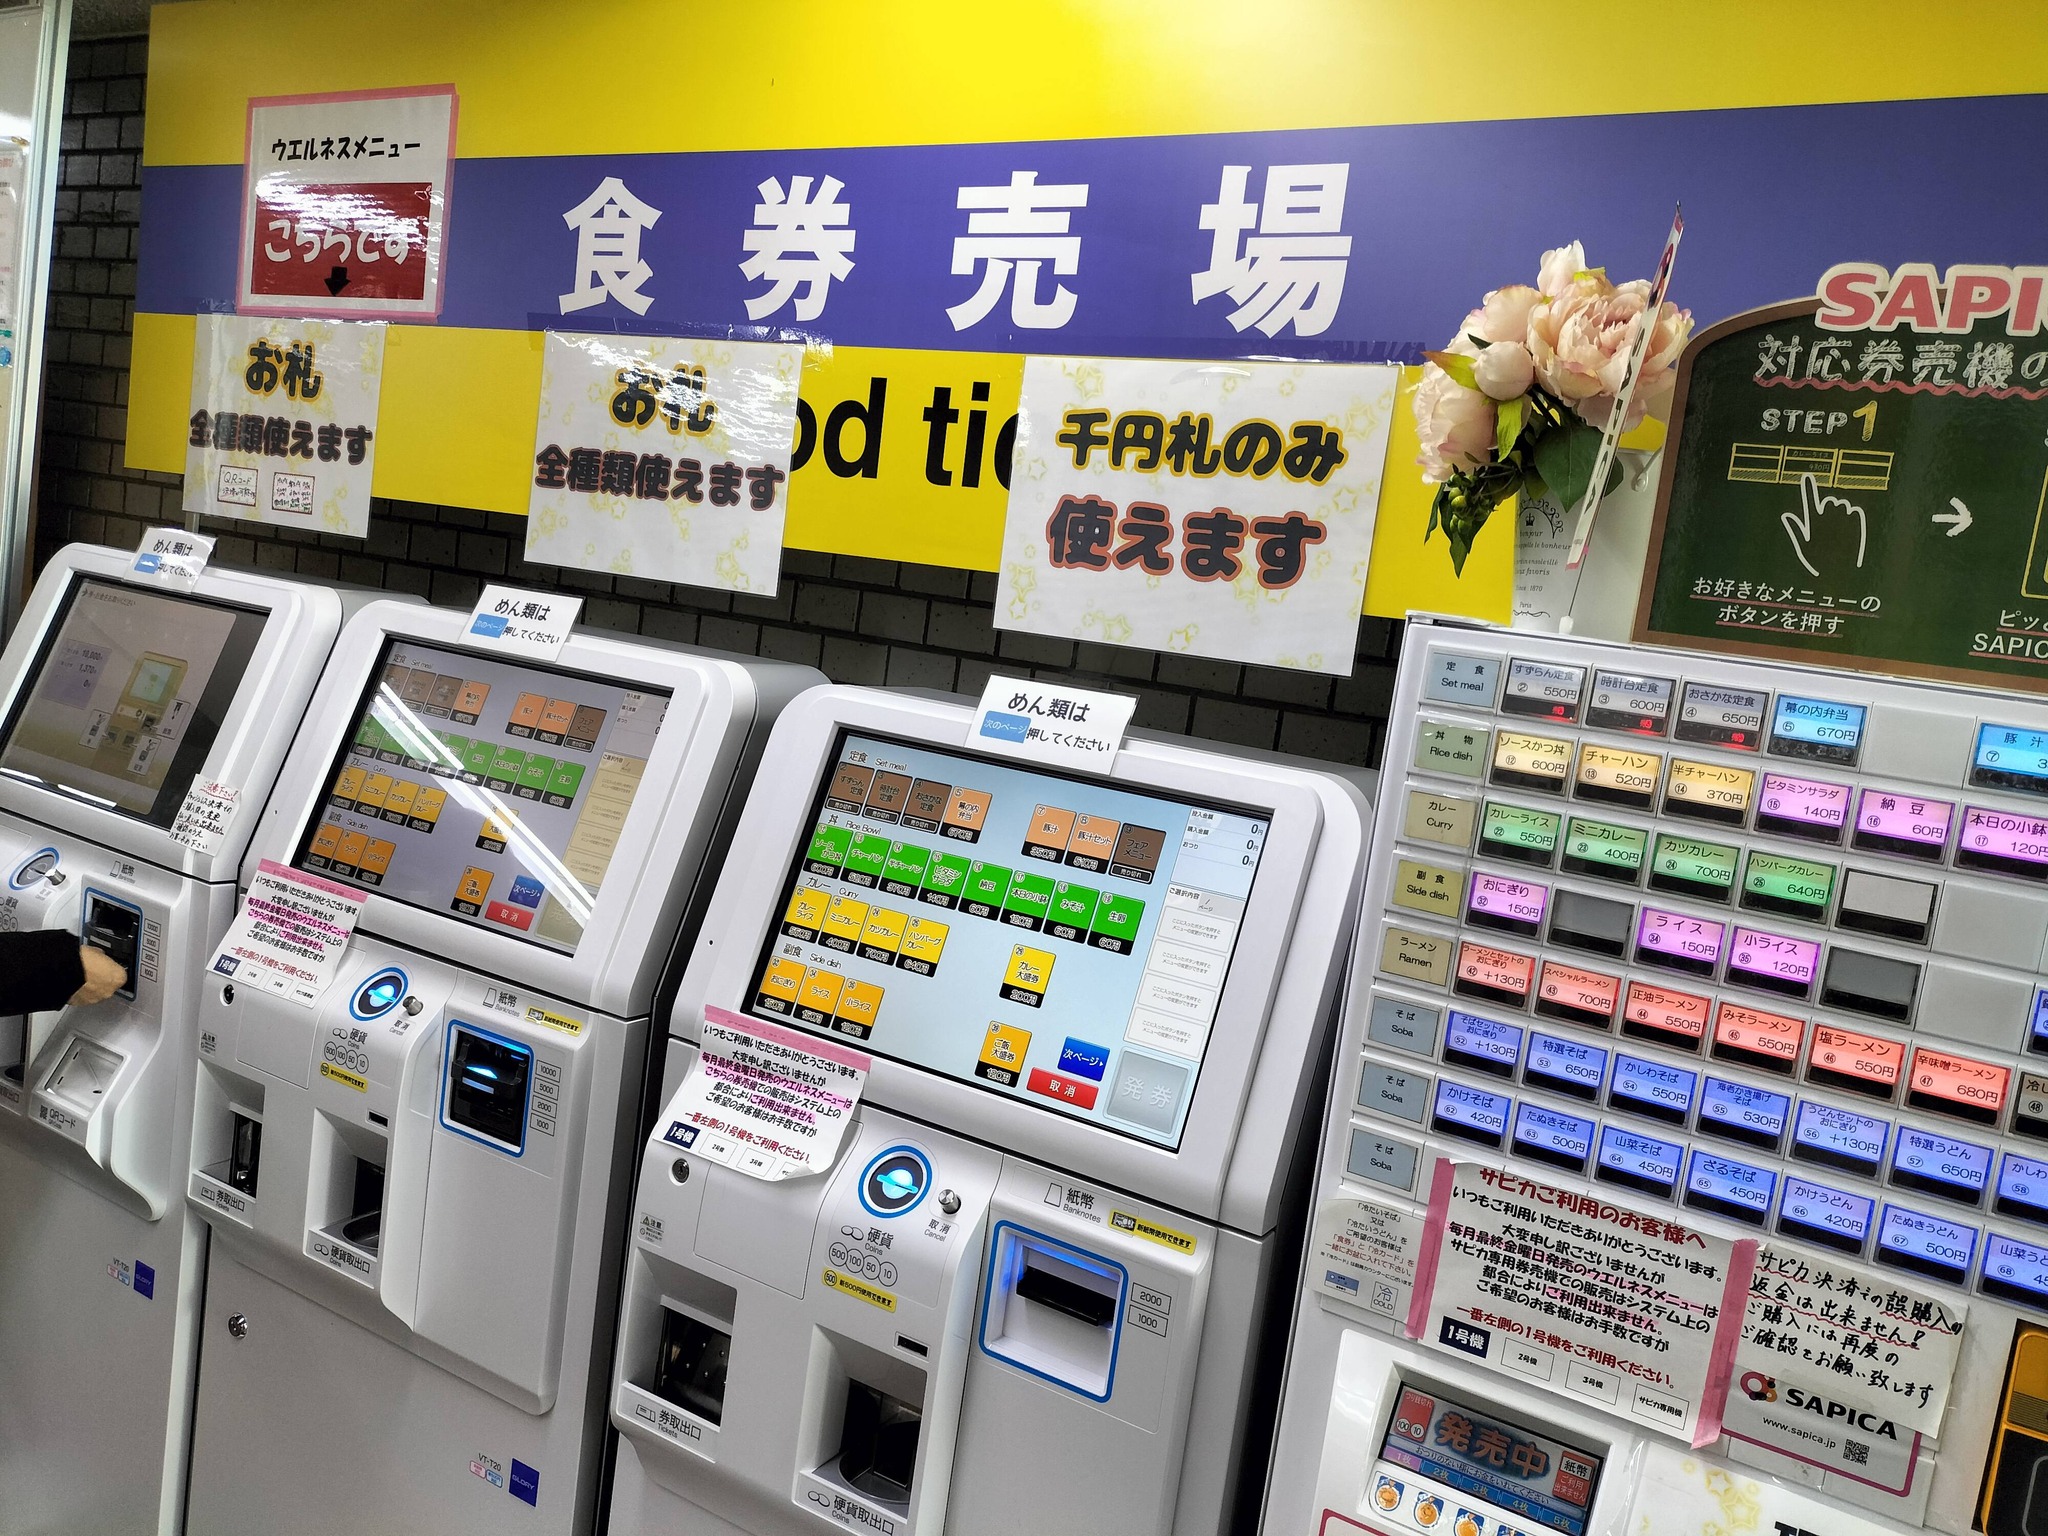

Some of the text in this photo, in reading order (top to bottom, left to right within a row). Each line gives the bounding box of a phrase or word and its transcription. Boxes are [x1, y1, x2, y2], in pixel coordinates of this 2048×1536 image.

[271, 138, 421, 163] ウエルネスメニュー
[264, 218, 410, 266] こちらです
[558, 162, 1353, 338] 食券売場
[246, 341, 322, 399] お札
[611, 366, 718, 435] お札
[189, 409, 373, 464] 全種類使えます
[1056, 407, 1349, 487] 千円札のみ
[535, 444, 785, 512] 全種類使えます
[153, 539, 193, 556] めん類は
[1046, 494, 1327, 590] 使えます
[1693, 577, 1881, 613] お好きなメニューの
[495, 598, 551, 621] めん類は
[1718, 605, 1845, 635] ボタンを押す
[502, 626, 560, 644] 押してください
[1446, 661, 1485, 676] 定食
[1514, 663, 1574, 681] すずらん定食
[1441, 677, 1484, 692] Set meal
[1543, 686, 1577, 699] 550円
[1600, 675, 1658, 694] 時計台定食
[1008, 692, 1091, 723] めん類は
[1629, 699, 1665, 713] 600円
[1688, 688, 1755, 707] おさかな定食
[1721, 712, 1758, 727] 650円
[1785, 702, 1849, 721] 幕の内弁当
[1026, 727, 1111, 753] 押してください
[1435, 730, 1474, 746] 丼物
[1817, 726, 1856, 742] 670円
[2003, 732, 2044, 747] 豚汁
[1429, 746, 1473, 762] Rice dish
[1500, 736, 1565, 756] ソースかつ丼
[849, 751, 868, 764] 定食
[1532, 759, 1565, 773] 600円
[1585, 751, 1649, 769] チャーハン
[1615, 773, 1652, 788] 520円
[1673, 764, 1740, 784] 半チャーハン
[1707, 789, 1743, 805] 370円
[1766, 779, 1840, 800] ビタミンサラダ
[1428, 800, 1457, 814] カレー
[1804, 806, 1841, 821] 140円
[1880, 797, 1925, 817] 納豆
[1426, 817, 1453, 831] Curry
[1489, 808, 1550, 829] カレーライス
[1970, 813, 2048, 837] 本日の小鉢
[1520, 830, 1553, 847] 550円
[1574, 823, 1636, 842] ミニカレー
[1912, 824, 1944, 839] 60円
[1665, 839, 1725, 860] カツカレー
[1416, 870, 1445, 885] 副食
[1750, 857, 1824, 878] ハンバーグカレー
[1406, 884, 1450, 902] Side dish
[1483, 879, 1529, 898] おにぎり
[1655, 915, 1703, 935] ライス
[1400, 936, 1437, 953] ラーメン
[1462, 944, 1525, 965] ラーメンとセットの
[1743, 934, 1798, 956] 小ライス
[1398, 952, 1433, 969] Ramen
[1476, 956, 1508, 969] おにぎり
[1483, 970, 1526, 988] +130円
[1544, 967, 1610, 989] スペシャルラーメン
[1632, 988, 1698, 1012] 正油ラーメン
[1395, 1009, 1416, 1021] そば
[1460, 1015, 1507, 1034] そばセットの
[1723, 1009, 1792, 1033] みそラーメン
[1391, 1023, 1414, 1038] Soba
[1466, 1024, 1497, 1039] おにぎり
[703, 1024, 859, 1081] いつもご利用いただきありがとうございます。
[1475, 1040, 1516, 1058] +130円
[1542, 1039, 1588, 1060] 特選そば
[1819, 1030, 1891, 1056] 塩ラーメン
[1062, 1048, 1100, 1067] 次ページ
[1917, 1055, 1997, 1080] 辛味噌ラーメン
[540, 1064, 557, 1077] 10000
[1624, 1061, 1679, 1084] かしわそば
[1854, 1059, 1895, 1077] 550円
[702, 1051, 853, 1109] 毎月最終金曜日発売のウエルネスメニューは
[1049, 1079, 1077, 1097] 取消
[1122, 1075, 1172, 1109] 発券
[1446, 1086, 1494, 1109] かけそば
[1733, 1094, 1752, 1107] そば
[1956, 1084, 1999, 1102] 680円
[1470, 1111, 1502, 1129] 420円
[1526, 1109, 1579, 1133] たぬきそば
[1743, 1110, 1780, 1128] 530円
[1808, 1105, 1874, 1129] うどんセットの
[1819, 1118, 1857, 1134] おにぎり
[1614, 1135, 1662, 1157] 山菜そば
[1829, 1133, 1879, 1154] +130円
[1909, 1135, 1972, 1160] 特選うどん
[1702, 1158, 1756, 1184] ざるそば
[1941, 1163, 1982, 1182] 650円
[1065, 1187, 1095, 1210] 紙幣
[1794, 1185, 1853, 1211] かけうどん
[1063, 1203, 1101, 1223] Banknotes
[1480, 1168, 1706, 1249] サピカご利用のお客様へ
[928, 1218, 952, 1235] 取消
[1453, 1186, 1722, 1282] いつもご利用いただきありがとうございます。
[1891, 1213, 1959, 1241] たぬきうどん
[867, 1226, 894, 1250] 硬貨
[864, 1242, 883, 1256] Coins
[1502, 1223, 1665, 1285] 大変申し訳ございませんが
[1925, 1241, 1966, 1262] 500円
[1449, 1221, 1718, 1319] 毎月最終金曜日発売のウエルネスメニューは
[1450, 1238, 1710, 1333] サピカ専用券売機での販売はシステム上の
[1760, 1251, 1963, 1336] サピカ決済での誤購入の
[1140, 1291, 1162, 1307] 2000
[1373, 1299, 1394, 1311] COLD
[1482, 1264, 1662, 1336] 都合によりご利用出来ません。
[1138, 1313, 1158, 1329] 1000
[1476, 1278, 1670, 1352] ご希望のお客様はお手数ですが
[1747, 1301, 1899, 1367] ご購入には再度の
[1456, 1306, 1676, 1389] 一番左側の1号機をご利用ください。
[1447, 1323, 1683, 1419] 1号機 2号機 3号機 サピカ専用機
[1741, 1324, 1934, 1409] ご確認をお願い致します
[1785, 1388, 1897, 1441] SAPICA
[659, 1409, 701, 1441] 券取出口
[1762, 1415, 1837, 1449] www.sapica.jp
[1436, 1412, 1549, 1479] 発売中
[478, 1453, 501, 1471] VT-T20
[1563, 1459, 1588, 1477] 紙幣
[512, 1474, 535, 1490] GLORY
[1553, 1481, 1586, 1502] 出来ません
[1559, 1474, 1585, 1491] ご利用
[834, 1493, 895, 1536] 硬貨取出口
